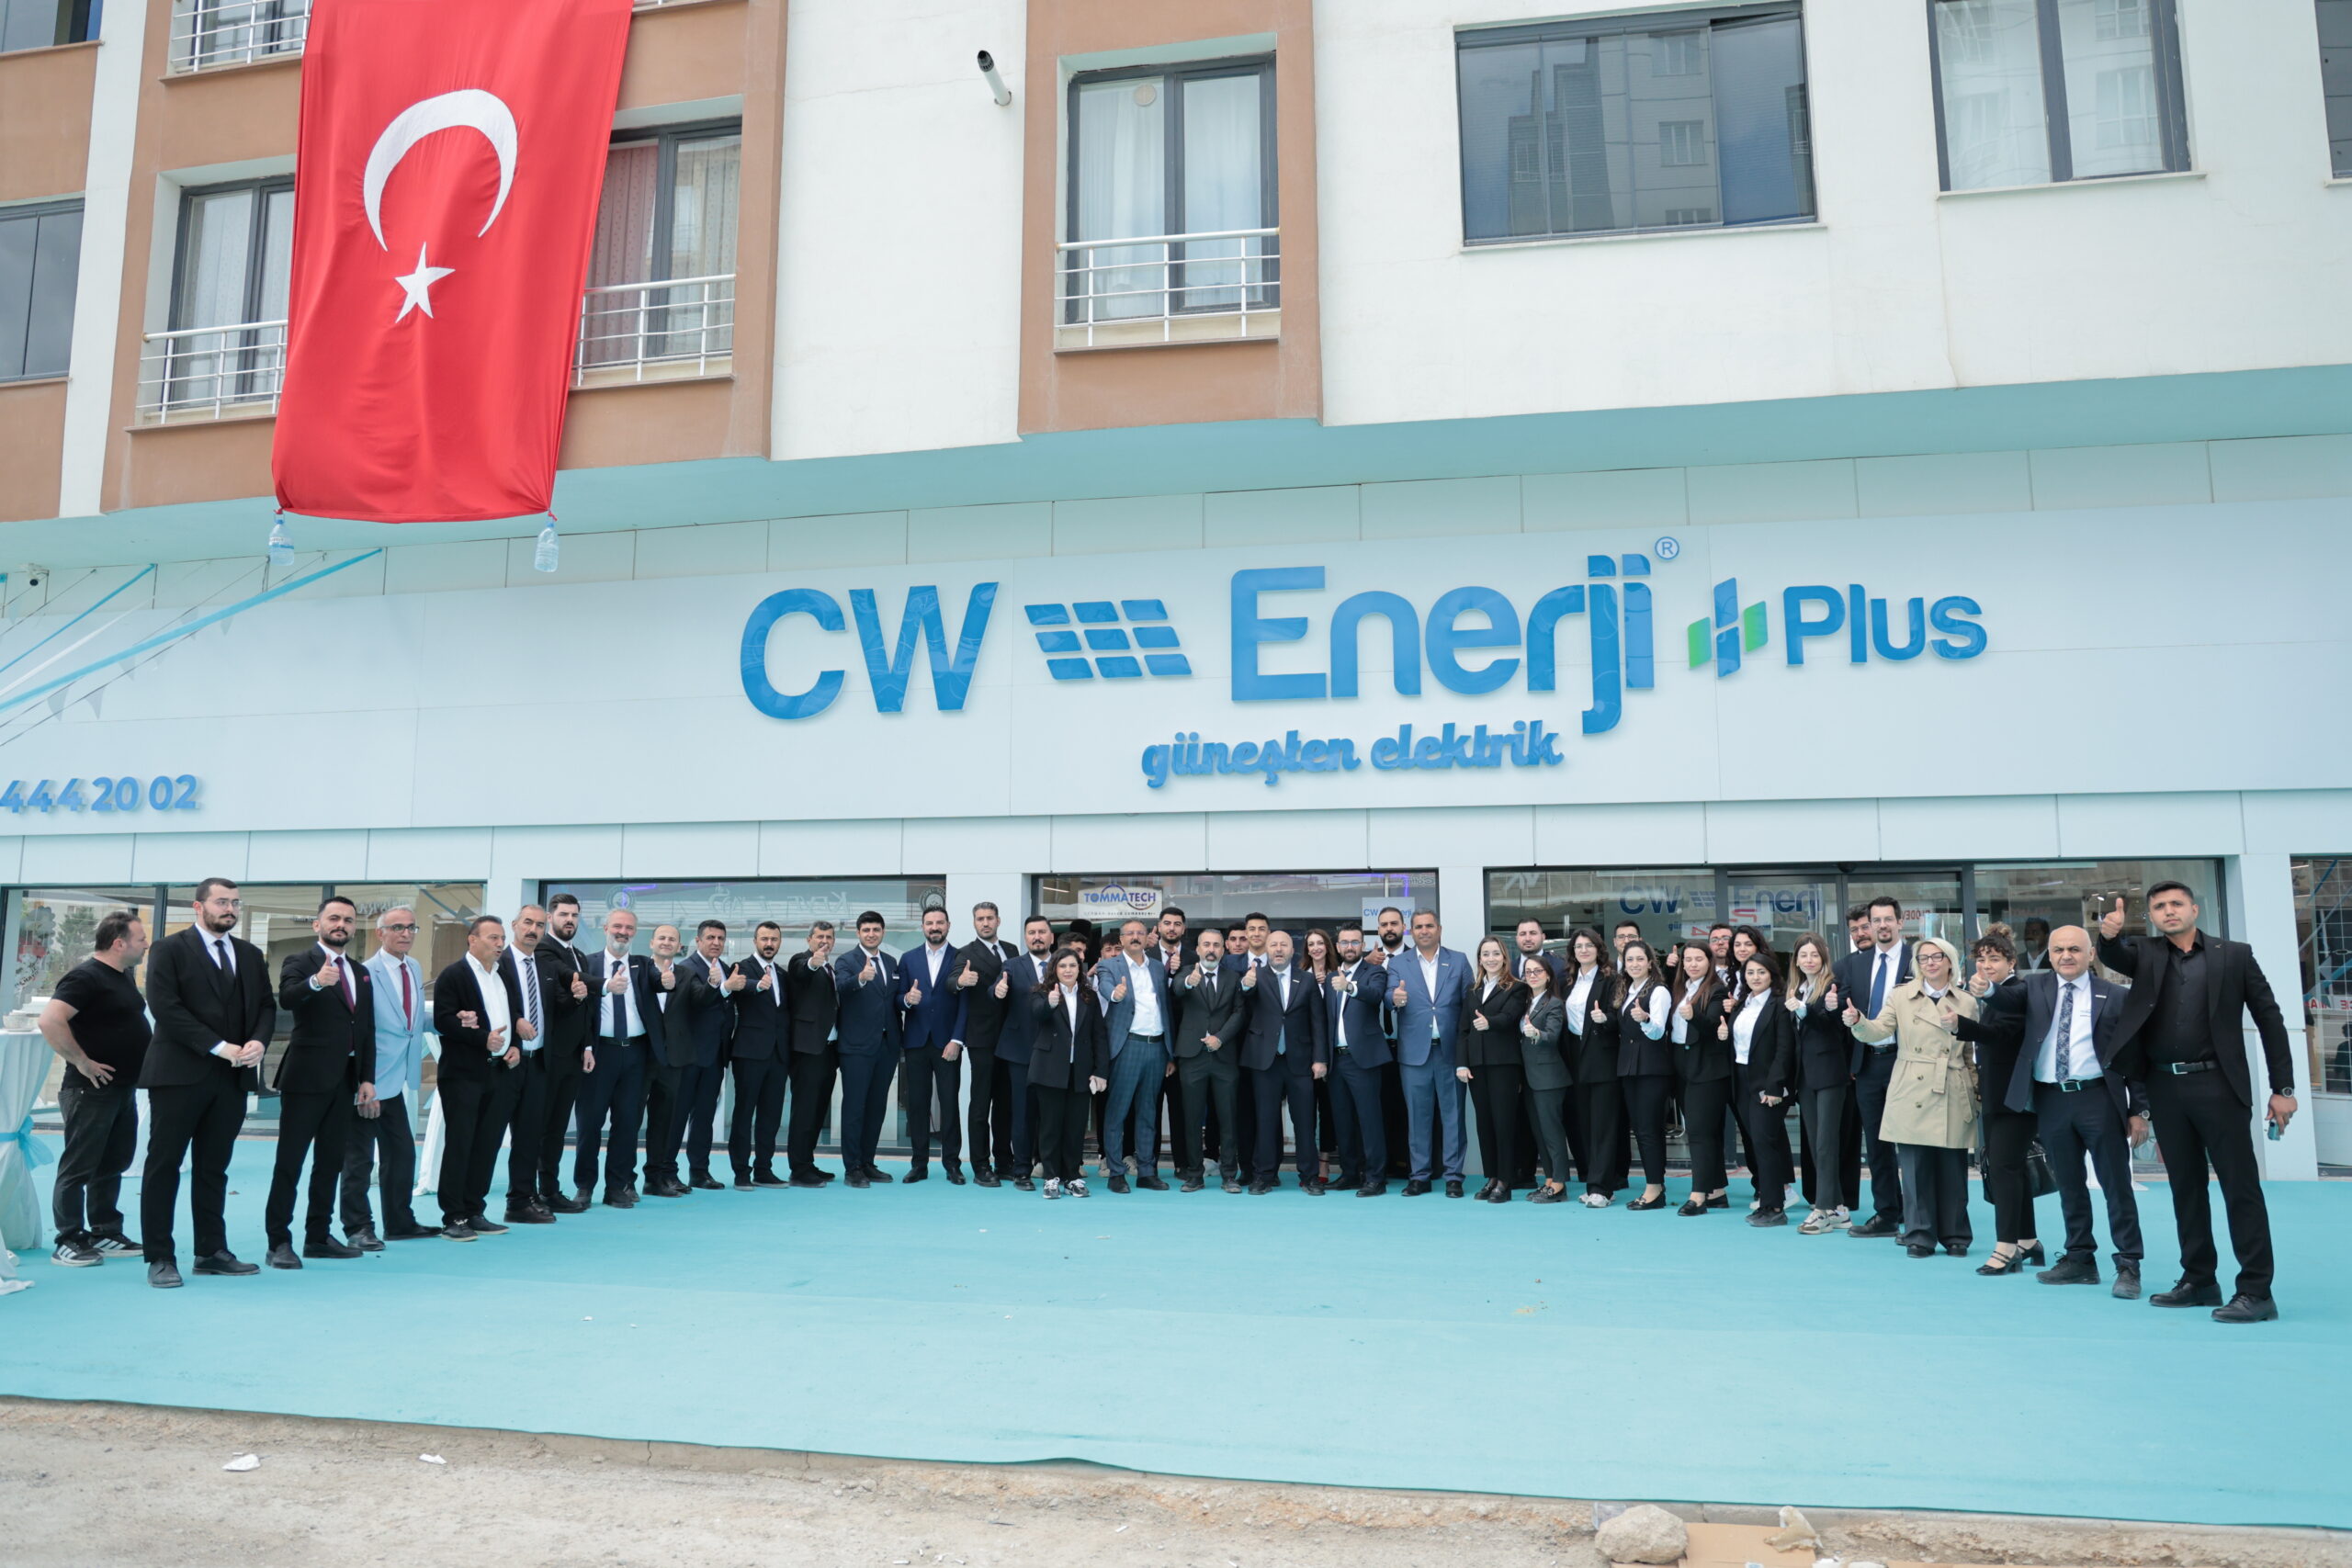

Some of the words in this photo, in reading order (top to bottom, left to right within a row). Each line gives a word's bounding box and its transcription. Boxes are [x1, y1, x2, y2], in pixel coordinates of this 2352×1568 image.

[741, 582, 1000, 720] CW
[1231, 553, 1655, 736] Enerji
[1781, 583, 1989, 667] Plus
[1141, 729, 1362, 789] güneşten
[1370, 719, 1565, 771] elektrik
[0, 779, 84, 813] 444
[91, 776, 140, 811] 20
[149, 774, 198, 810] 02
[1084, 892, 1156, 903] TOMMATECH
[1363, 908, 1378, 917] CW
[1619, 886, 1680, 915] CW
